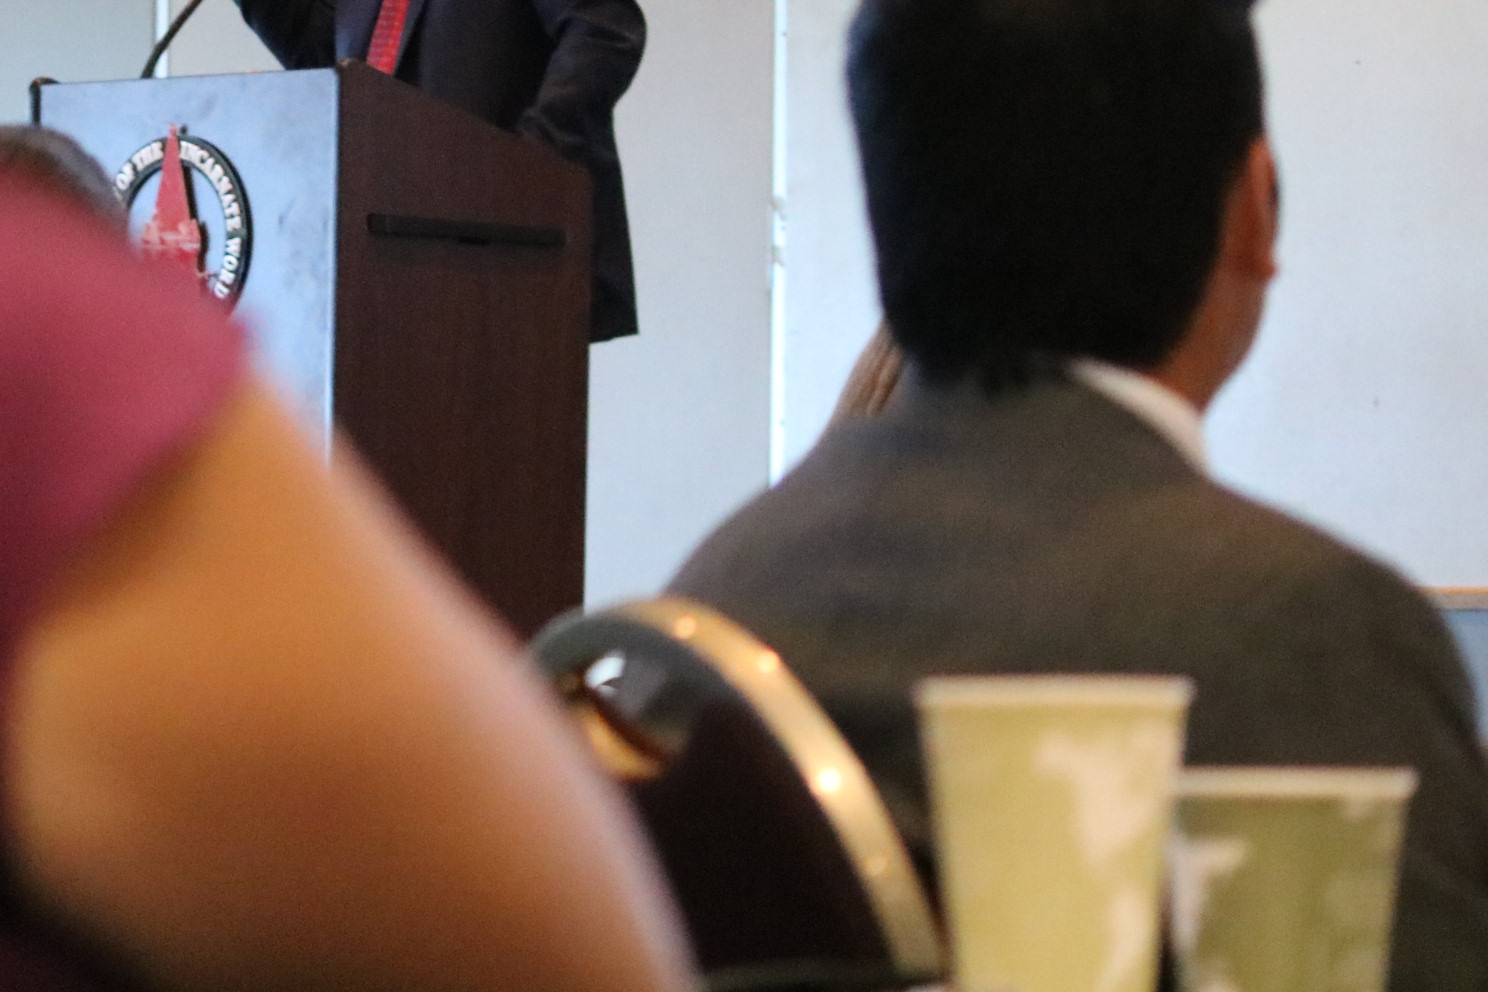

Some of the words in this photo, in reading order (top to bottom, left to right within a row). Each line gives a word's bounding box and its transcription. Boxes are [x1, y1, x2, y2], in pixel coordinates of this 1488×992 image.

[115, 162, 136, 191] OF
[132, 141, 164, 172] THE
[179, 140, 242, 232] INCARNATE
[213, 237, 242, 299] WORD
